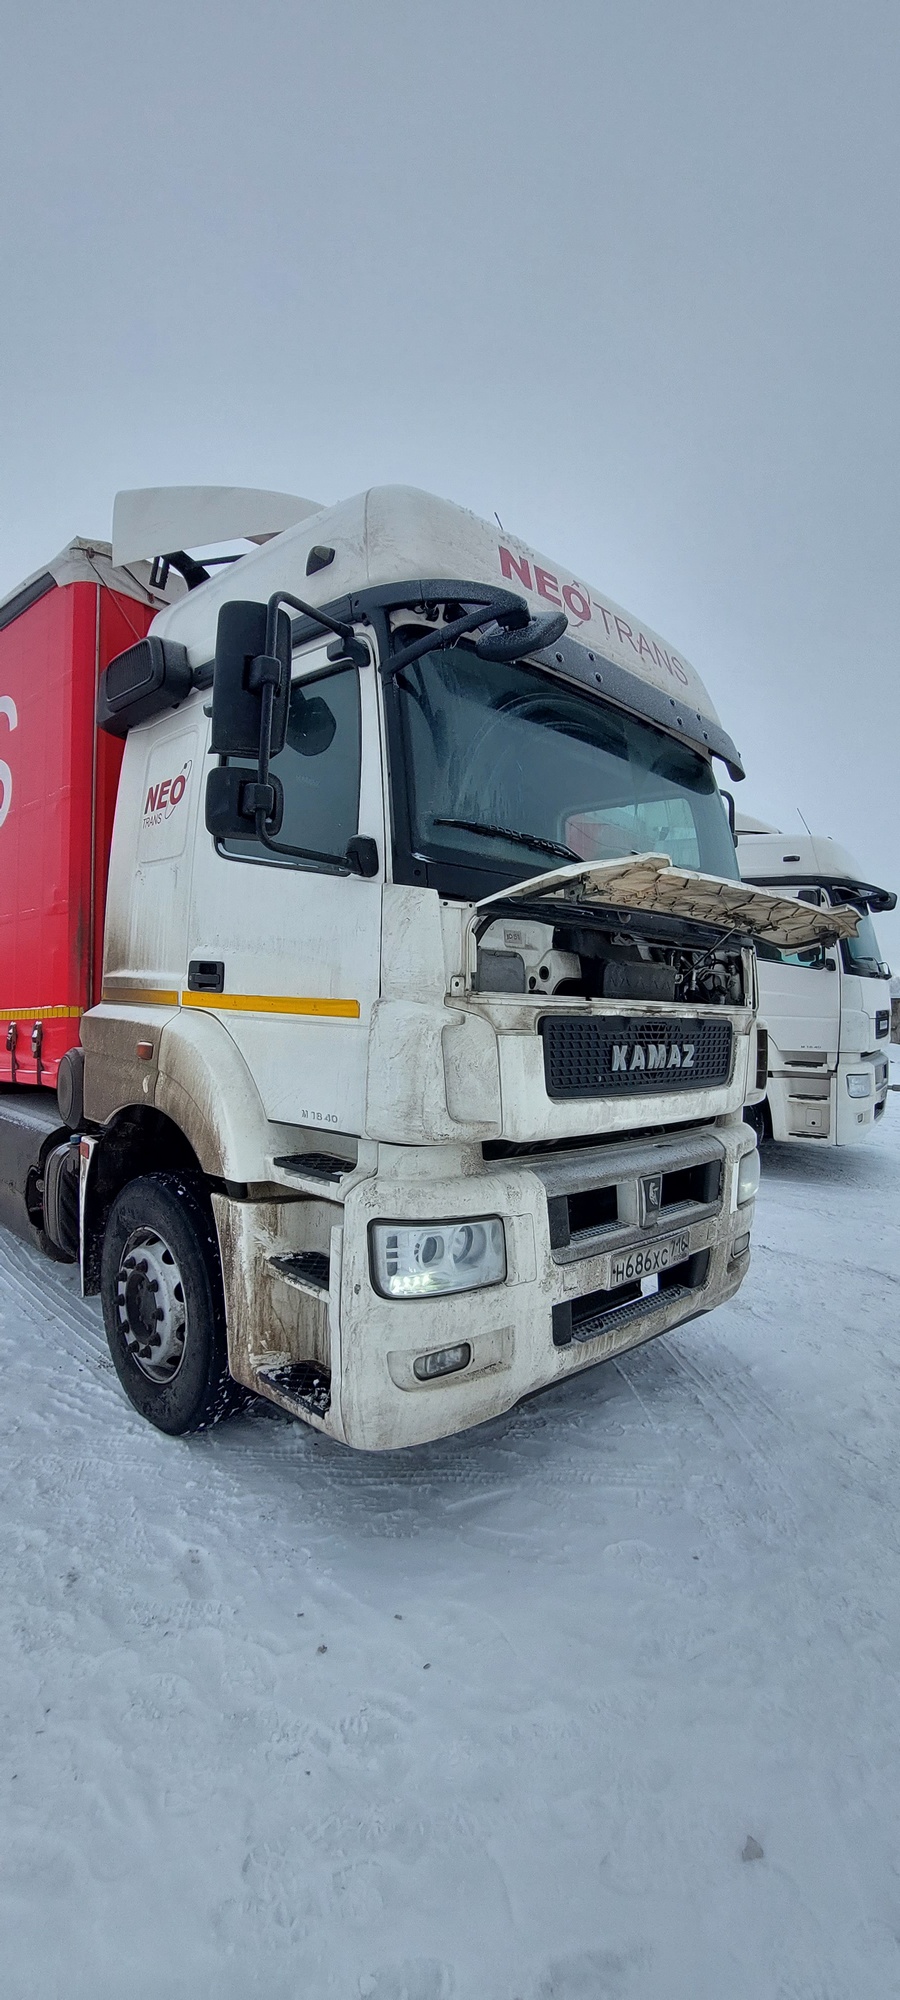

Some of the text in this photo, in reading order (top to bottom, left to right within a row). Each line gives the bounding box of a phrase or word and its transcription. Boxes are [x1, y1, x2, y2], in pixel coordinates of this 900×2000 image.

[498, 545, 689, 686] NEO TRANS
[144, 775, 186, 815] NEO
[142, 813, 162, 829] TRANS
[611, 1043, 695, 1071] KAMAZ
